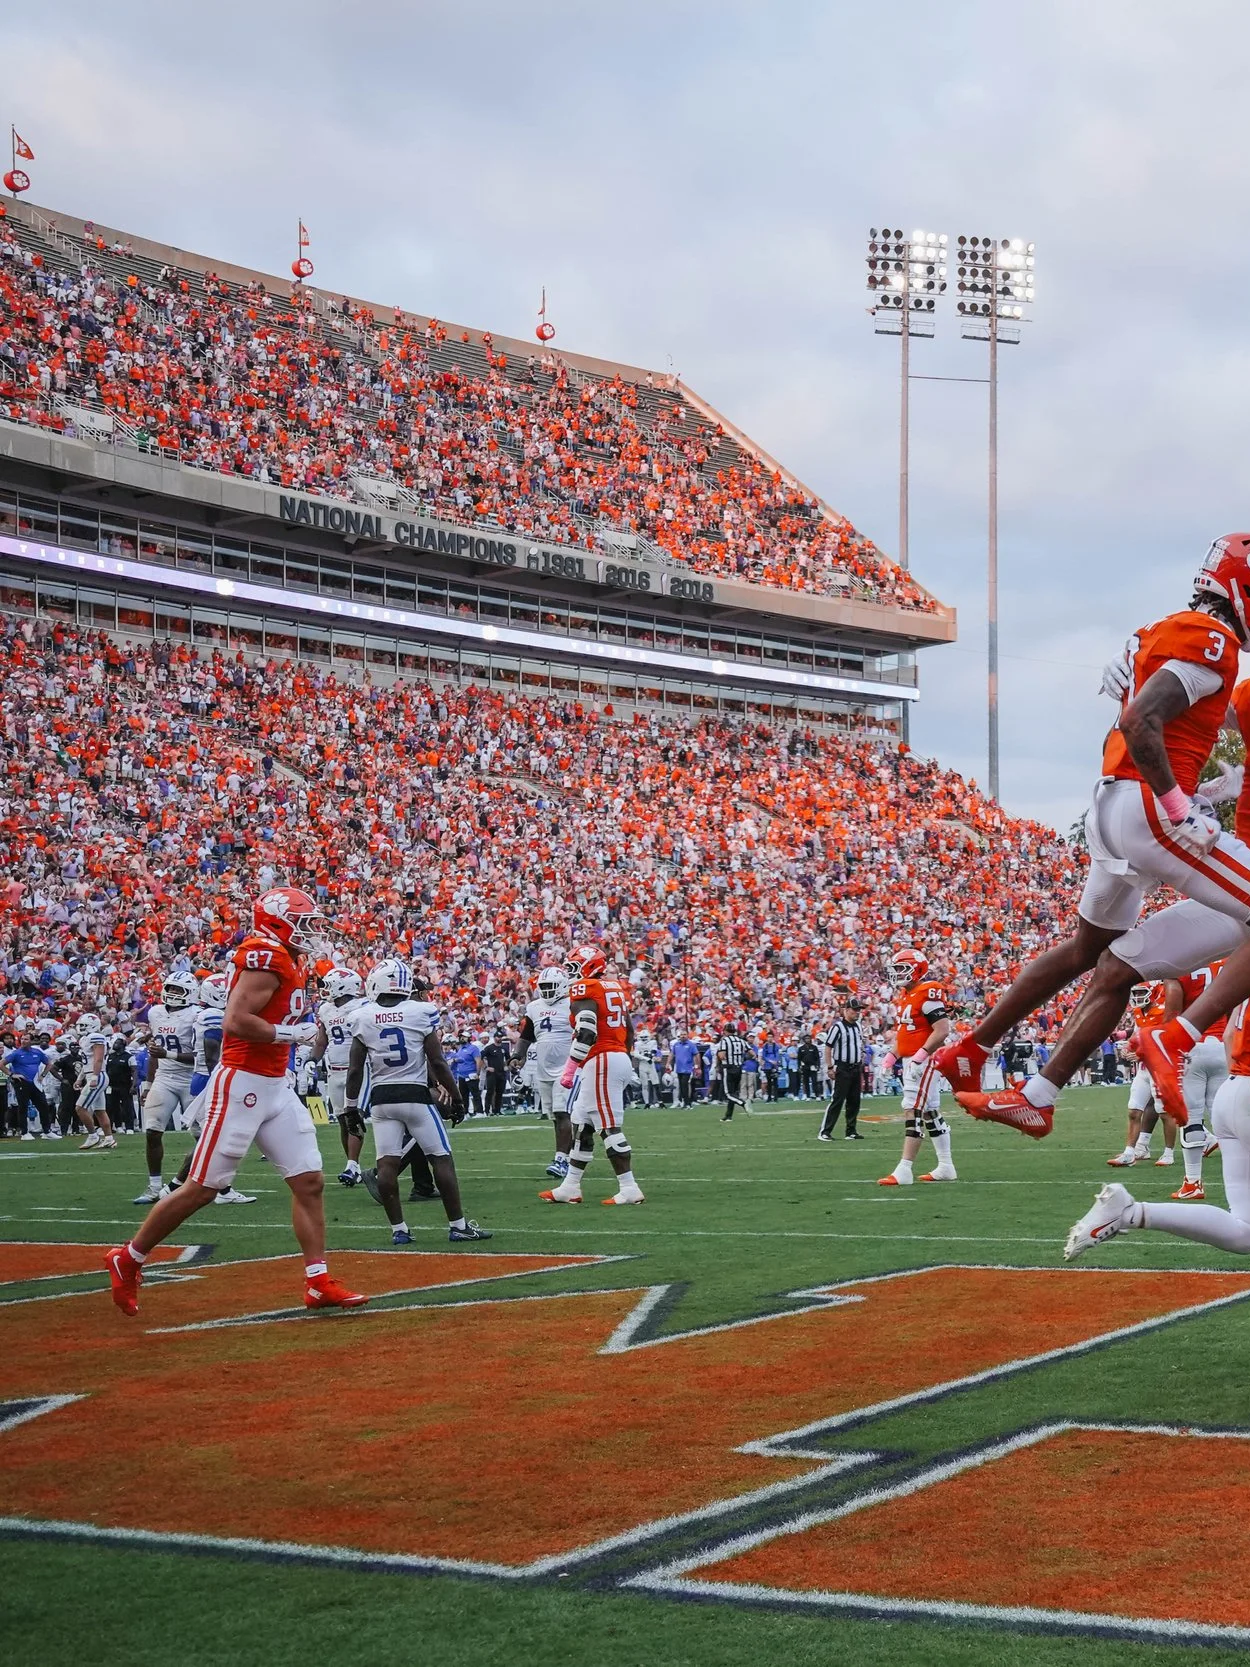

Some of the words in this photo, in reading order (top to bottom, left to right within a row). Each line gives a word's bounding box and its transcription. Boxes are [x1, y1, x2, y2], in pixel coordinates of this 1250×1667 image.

[280, 496, 387, 541] NATIONAL
[395, 522, 516, 566] CHAMPIONS
[542, 551, 586, 580] 1981
[605, 565, 651, 591] 2016
[670, 576, 714, 601] 2018
[1203, 630, 1226, 662] 3
[245, 950, 273, 969] 87
[571, 984, 586, 997] 59
[928, 988, 942, 1000] 64
[329, 1017, 345, 1026] SMU
[375, 1012, 403, 1024] MOSES
[540, 1017, 552, 1033] 4
[158, 1026, 176, 1034] SMU
[379, 1027, 409, 1067] 3
[956, 1056, 972, 1077] NIKE
